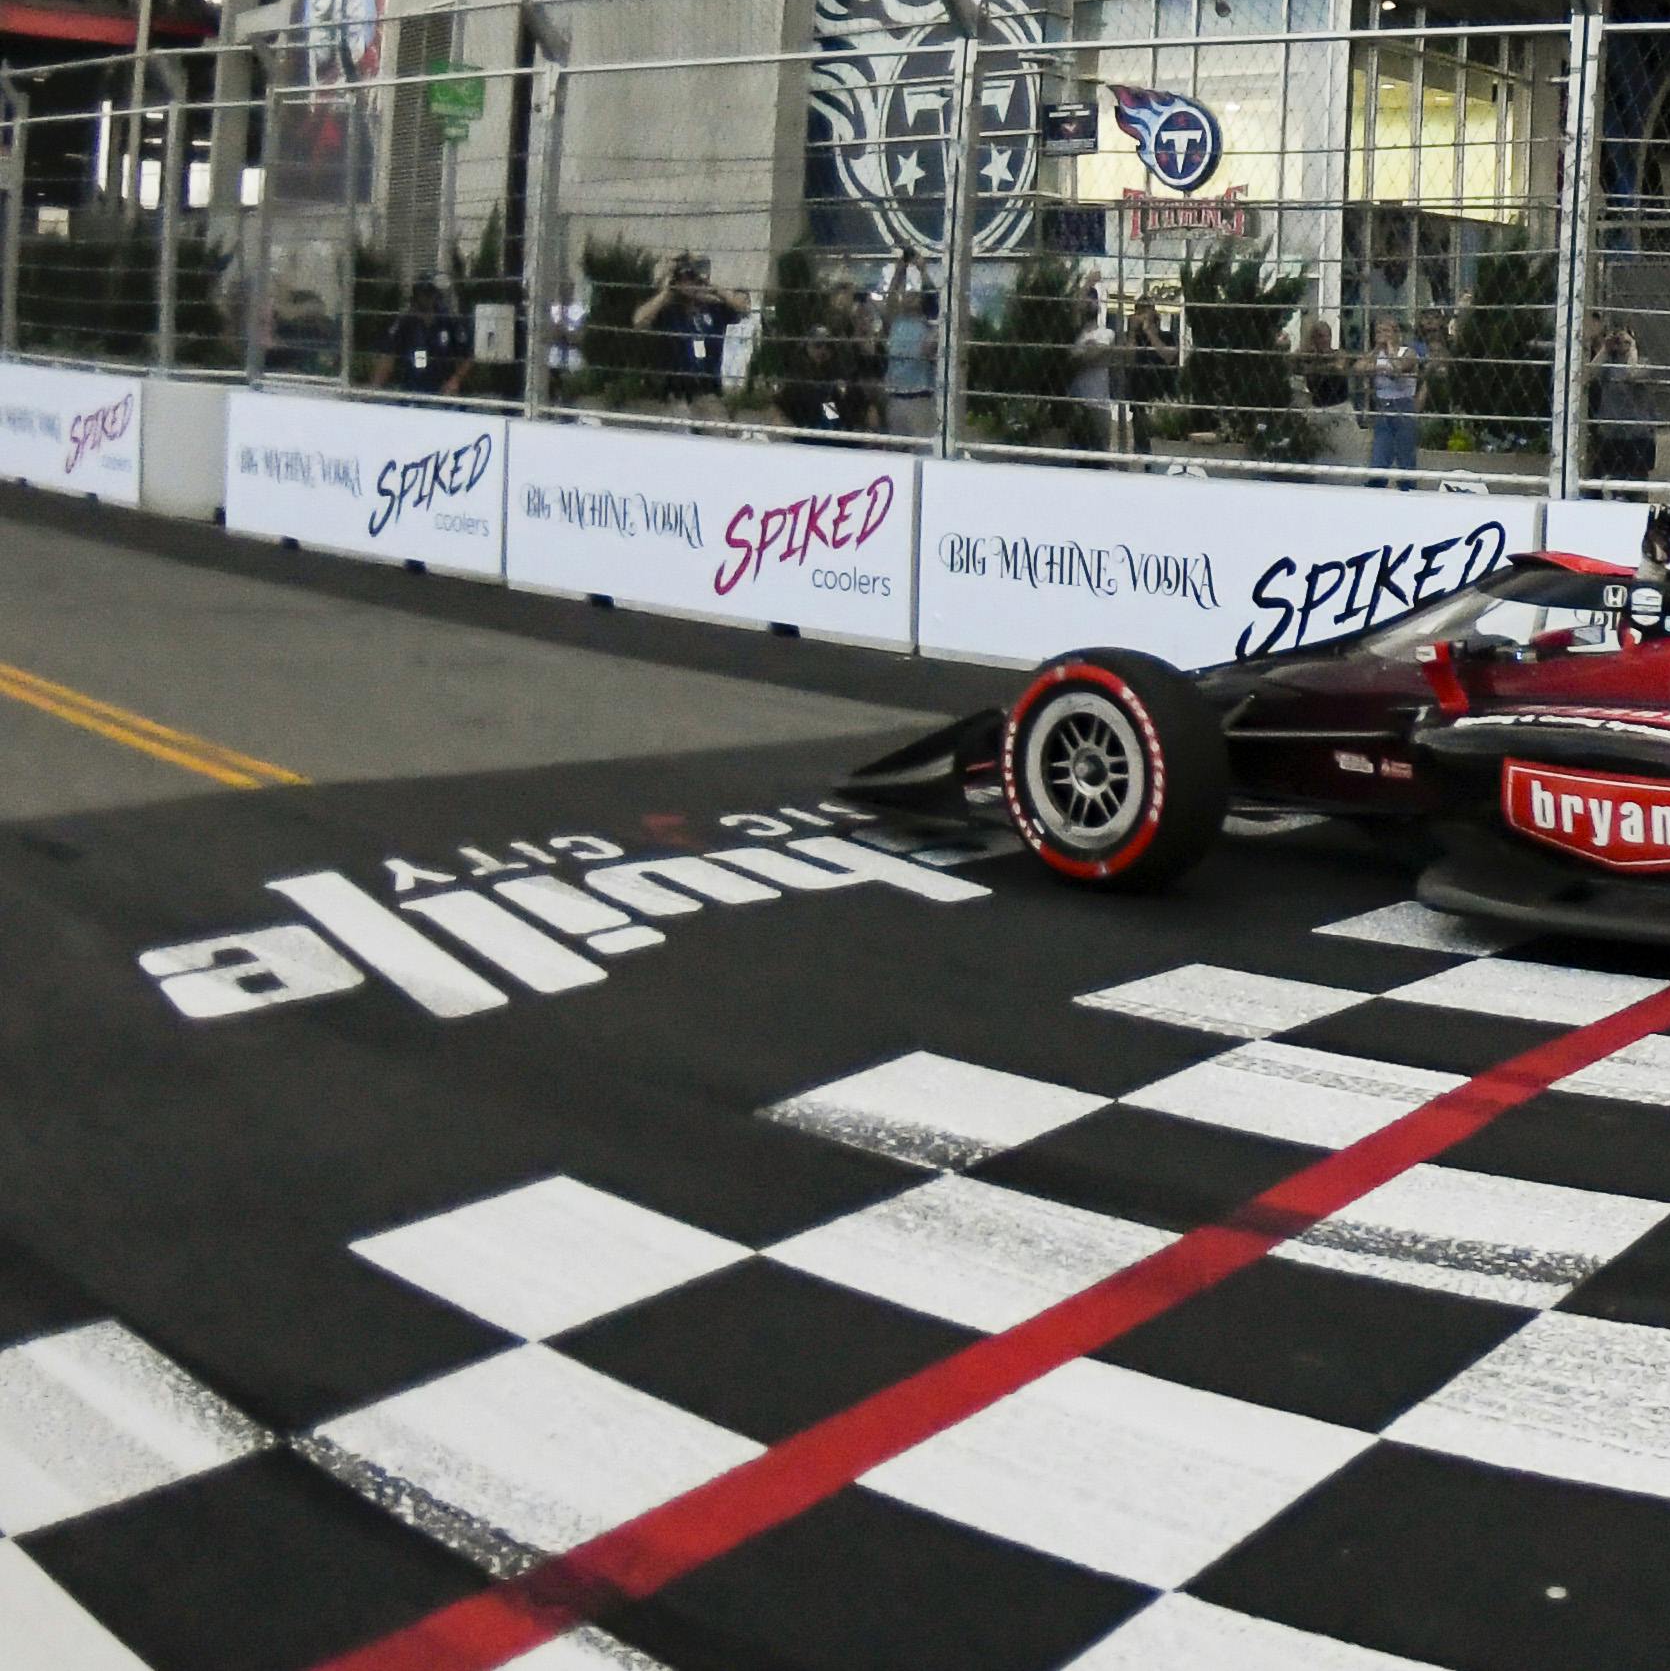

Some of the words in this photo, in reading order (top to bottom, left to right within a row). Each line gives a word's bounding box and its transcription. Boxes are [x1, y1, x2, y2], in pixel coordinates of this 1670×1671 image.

[368, 432, 492, 537] SPIKED
[522, 482, 551, 520] BIG
[556, 485, 637, 538] MACHINE
[634, 492, 704, 549] VODKA
[714, 475, 894, 596] SPIKED
[811, 566, 892, 596] coolers
[938, 530, 987, 577] BIG
[992, 536, 1119, 598] MACHINE
[1119, 543, 1221, 610] VODKA
[1235, 520, 1507, 662] SPIKED
[383, 834, 626, 892] CITY
[136, 836, 994, 1019] hville
